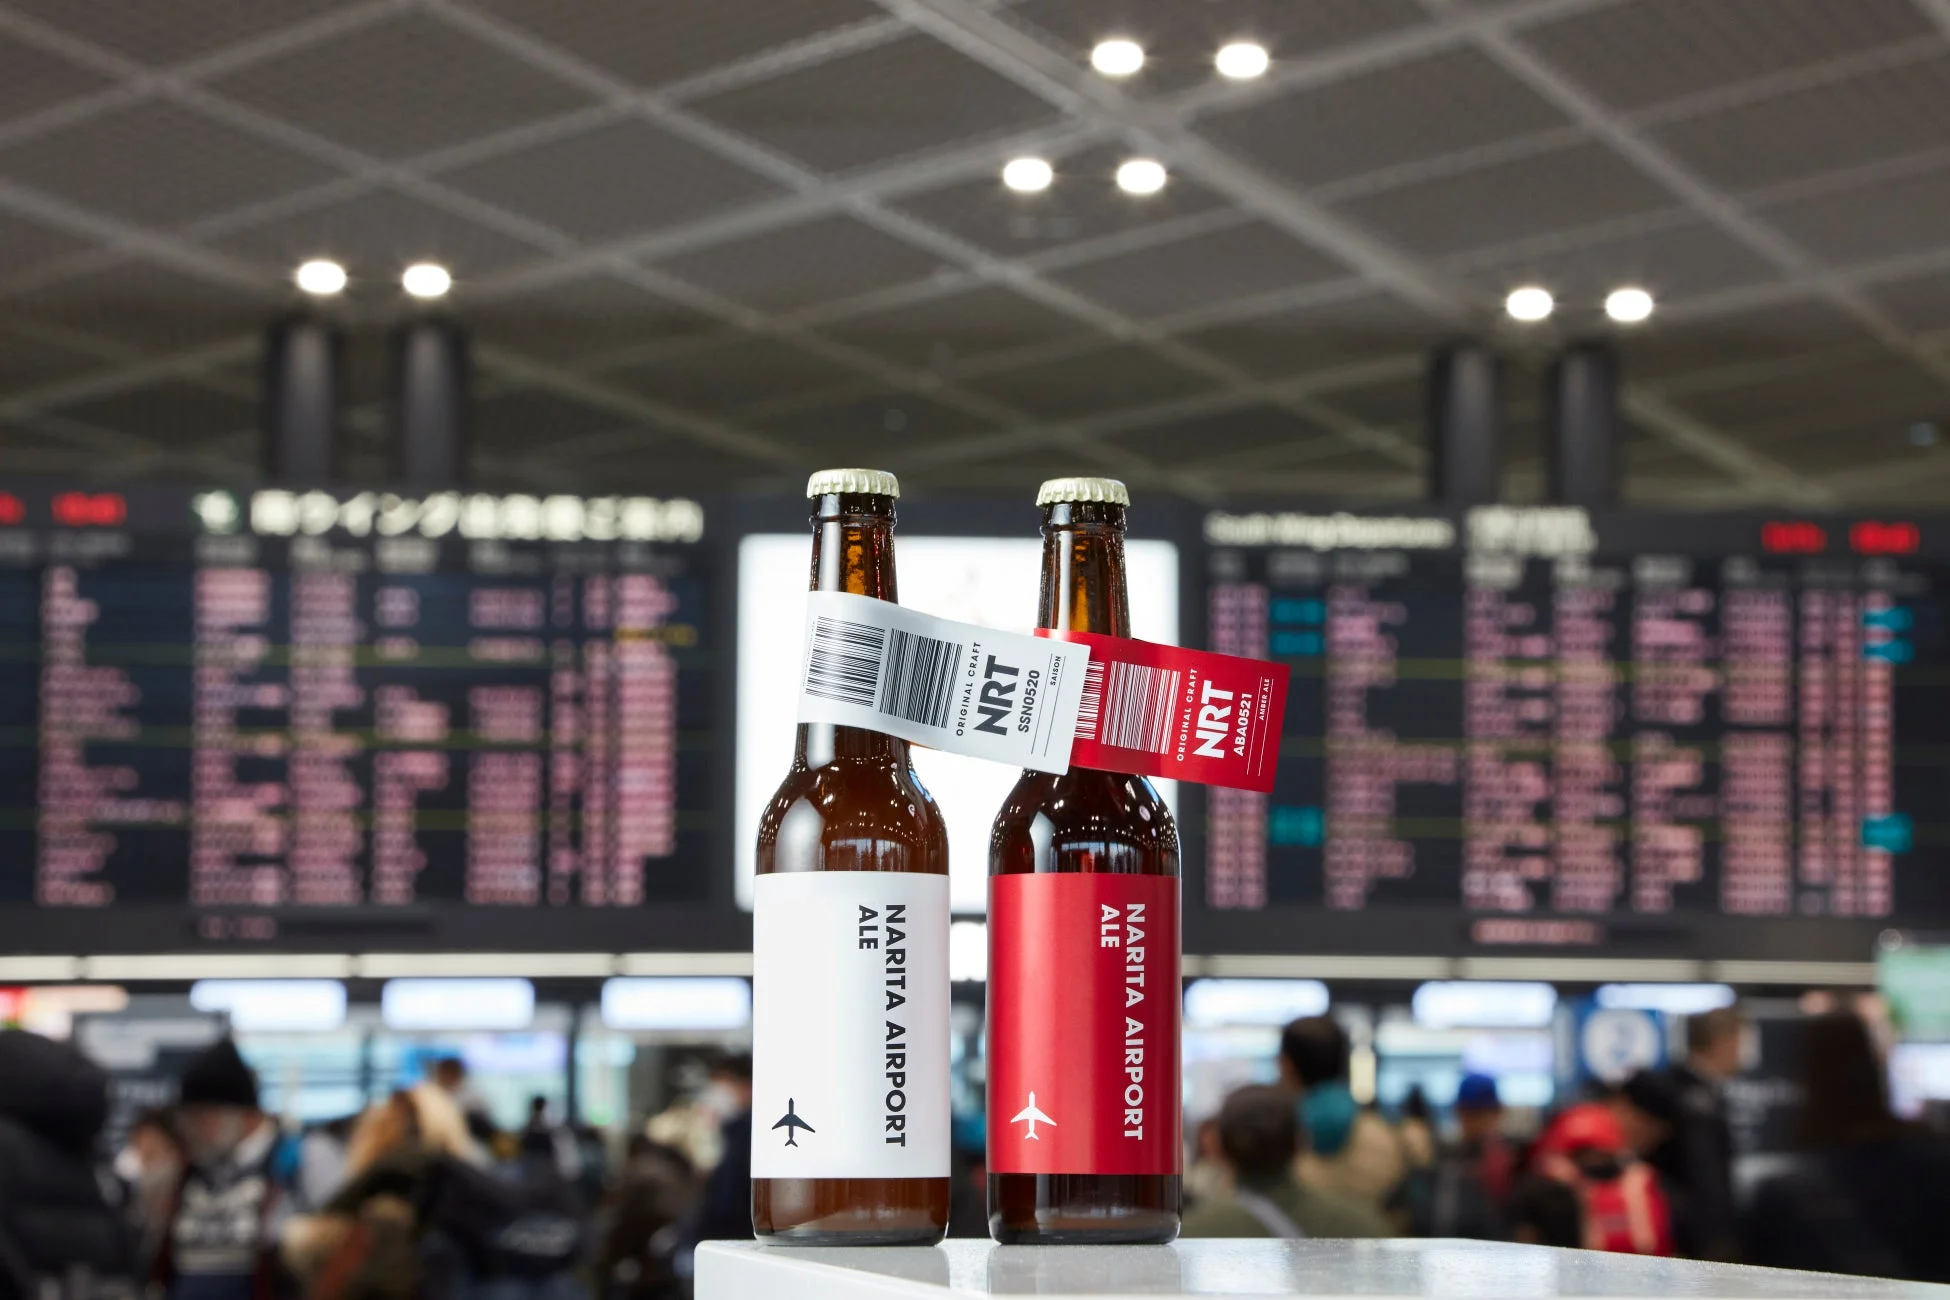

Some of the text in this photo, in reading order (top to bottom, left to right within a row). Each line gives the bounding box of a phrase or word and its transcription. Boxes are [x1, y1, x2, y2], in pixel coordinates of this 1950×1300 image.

[956, 643, 981, 736] ORIGINAL CRAFT
[973, 655, 1019, 736] NRT
[1018, 670, 1040, 733] SSN0520
[1050, 656, 1061, 685] SAISON
[1177, 669, 1198, 762] ORIGINAL CRAFT
[1192, 680, 1233, 759] NRT
[1233, 693, 1252, 756] ABA0521
[1258, 693, 1267, 720] AMBER
[858, 905, 878, 950] ALE
[1101, 904, 1119, 948] ALE
[885, 904, 906, 1147] NARITA AIRPORT
[1124, 903, 1145, 1141] NARITA AIRPORT
